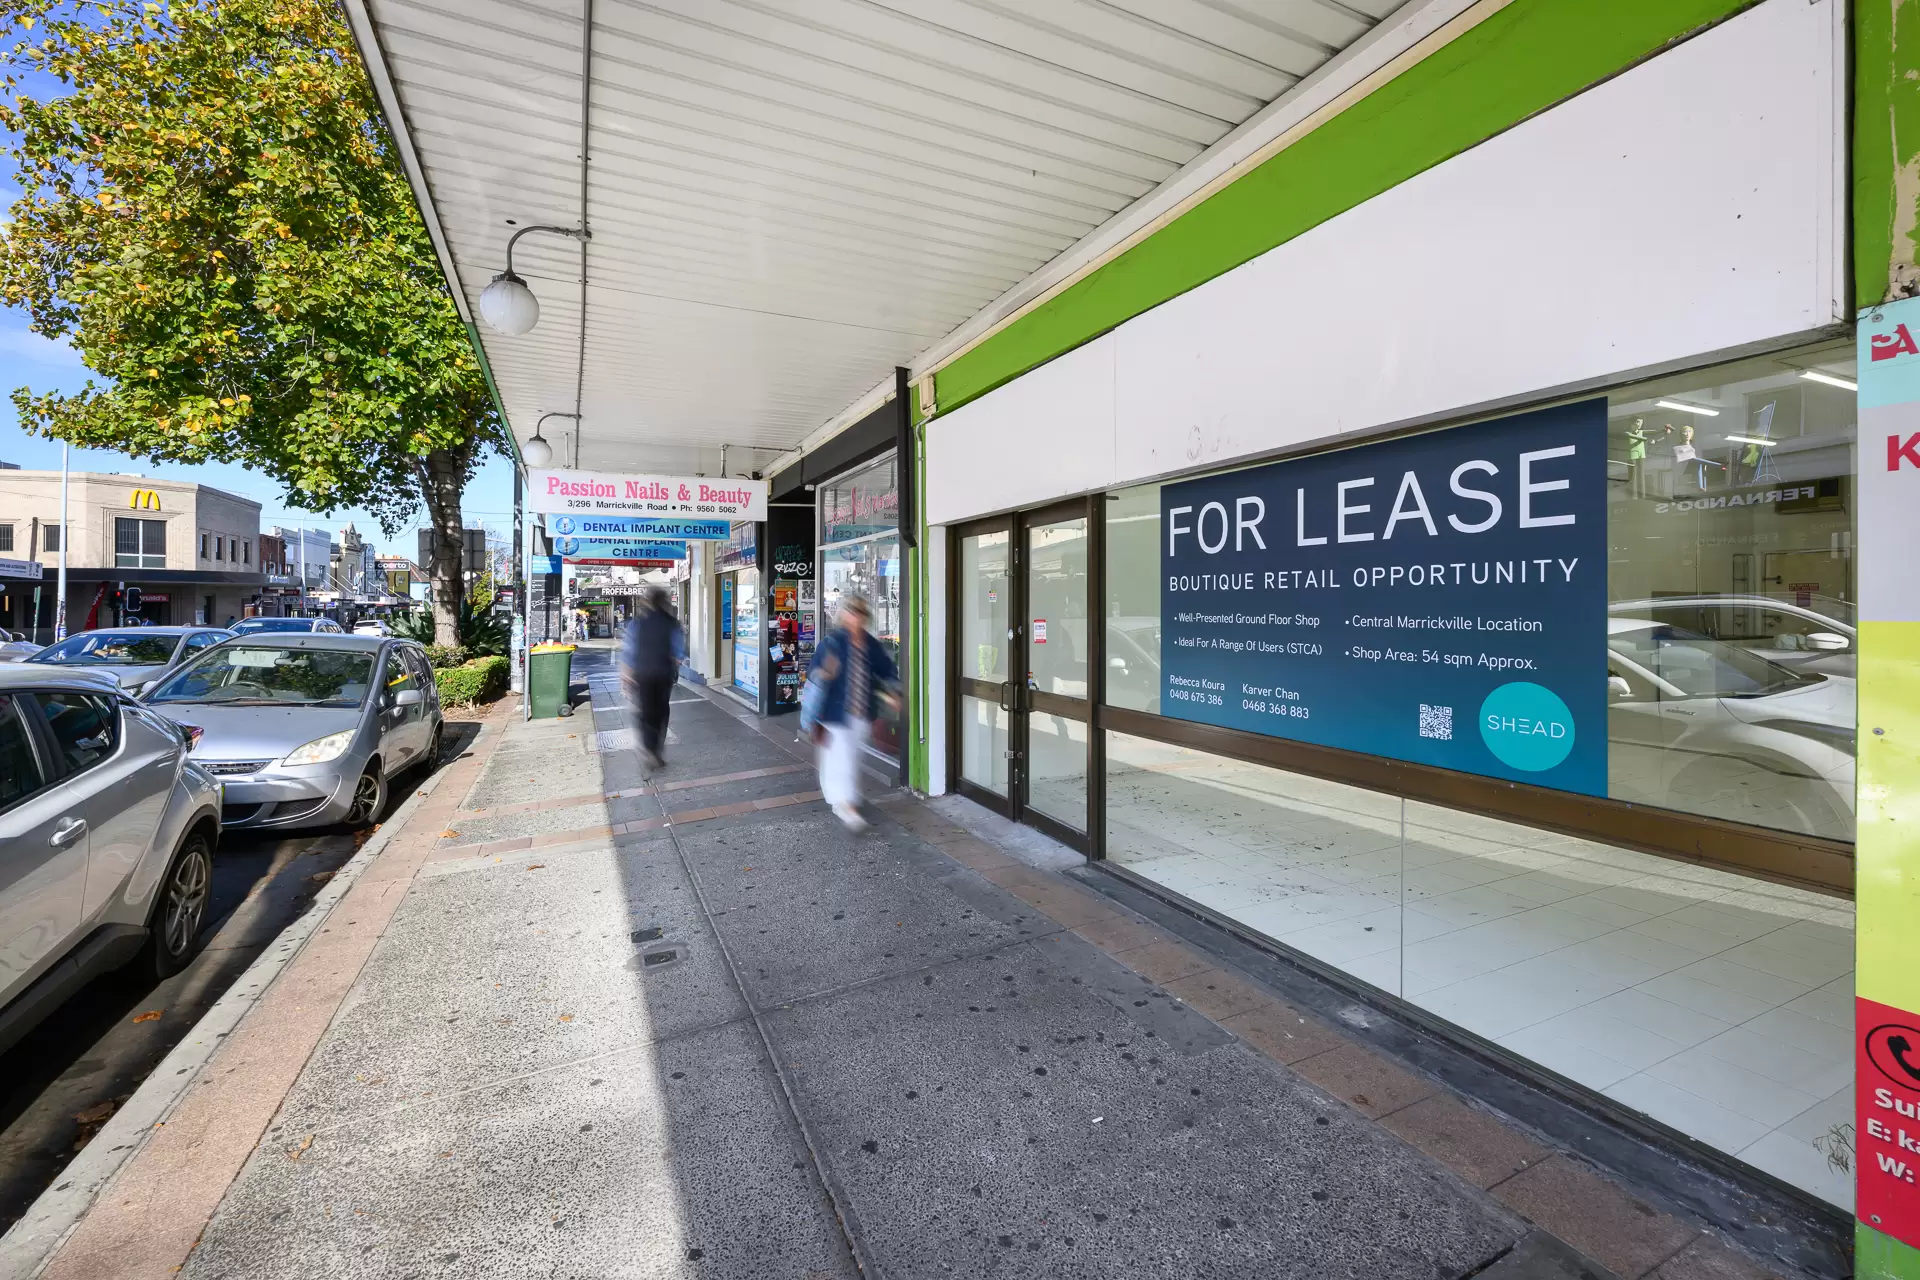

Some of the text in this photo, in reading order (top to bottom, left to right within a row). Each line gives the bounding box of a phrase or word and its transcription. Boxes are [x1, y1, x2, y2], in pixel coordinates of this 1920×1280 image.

[547, 476, 752, 508] Passion Nails & Beauty
[1169, 444, 1576, 557] FOR LEASE
[568, 500, 591, 508] 3/296
[596, 501, 642, 510] Marrickville
[584, 522, 724, 534] DENTAL IMPLANT CENTRE
[612, 548, 659, 557] CENTRE
[1169, 558, 1579, 592] BOUTIQUE RETAIL OPPORTUNITY
[1178, 613, 1320, 628] Well-Presented Ground Floor Shop
[1352, 615, 1542, 632] Central Marrickville Location
[1178, 637, 1322, 656] Ideal For A Range Of Users (STCA)
[1352, 646, 1537, 671] Shop Area: 54 sqm Approx.
[1170, 675, 1225, 690] Rebecca Koura
[1242, 684, 1299, 700] Karver Chan
[1170, 689, 1222, 705] 0408 675 386
[1242, 700, 1309, 719] 0468 368 883
[1487, 715, 1565, 738] SHEAD
[1867, 1118, 1891, 1142] E:
[1876, 1152, 1914, 1183] W:
